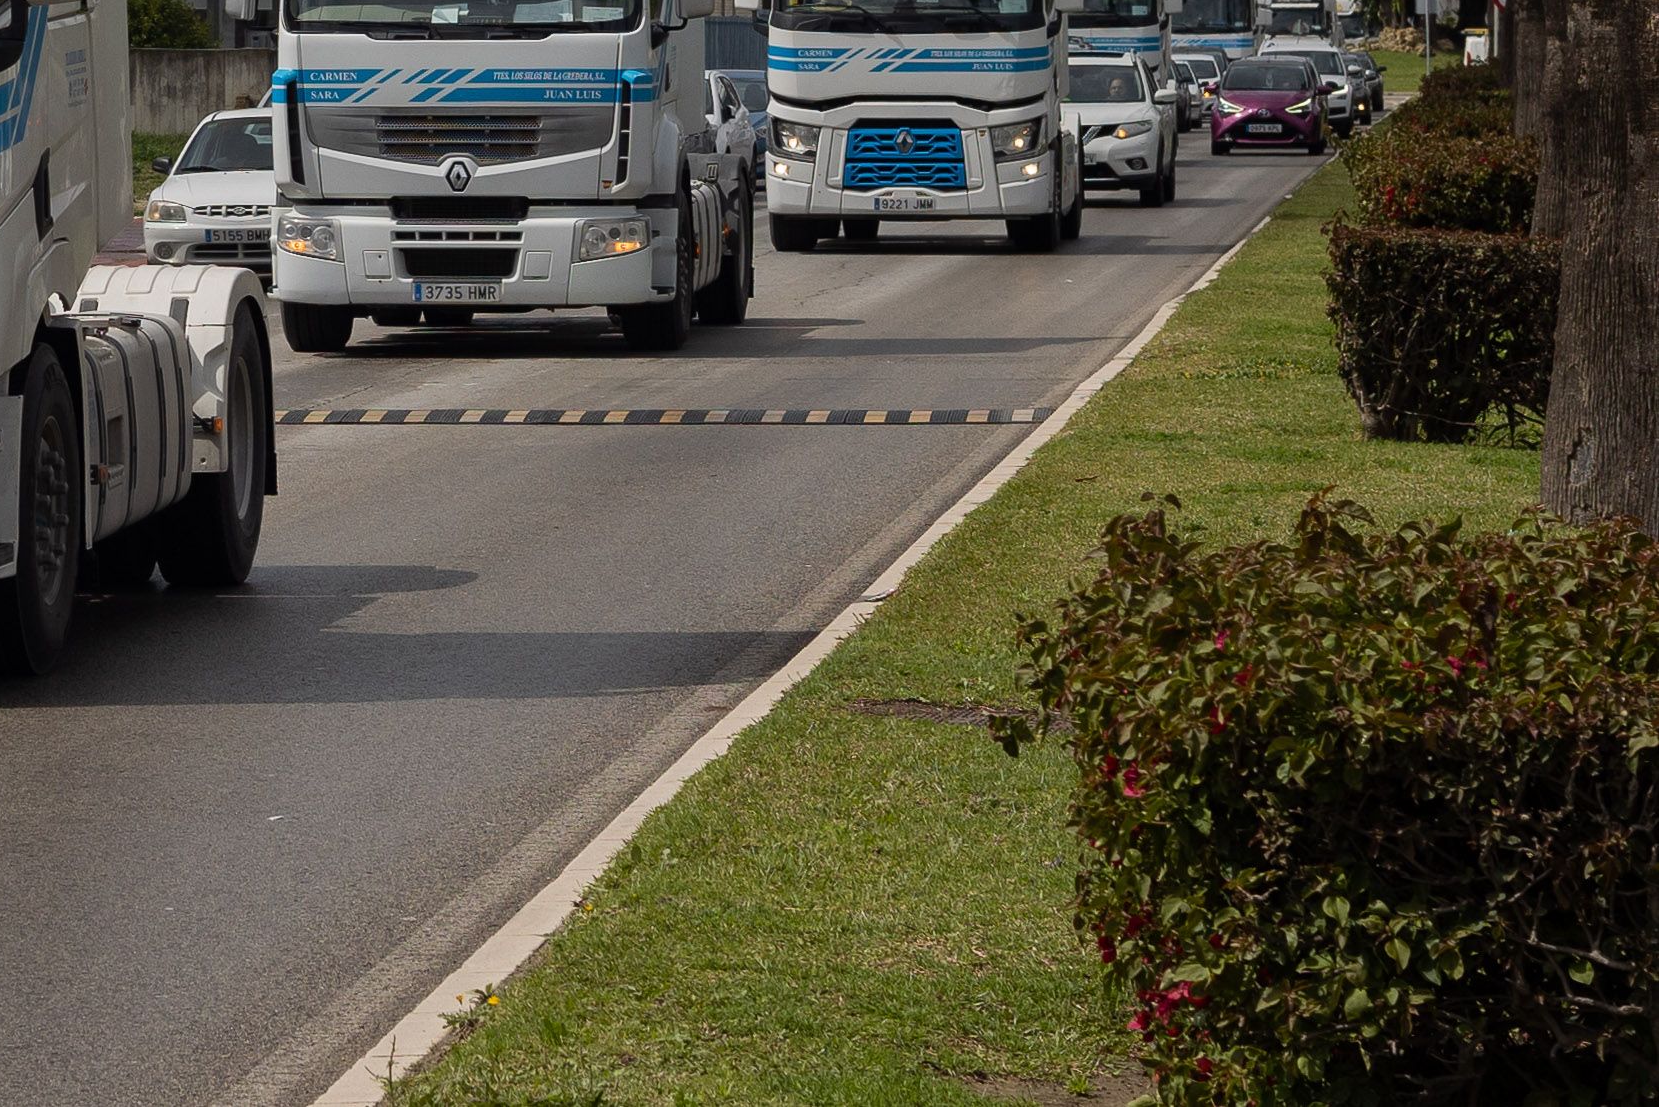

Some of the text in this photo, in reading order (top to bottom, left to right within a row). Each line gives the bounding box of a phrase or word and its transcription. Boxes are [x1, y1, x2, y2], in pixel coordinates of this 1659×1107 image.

[797, 49, 834, 57] CARMEN
[310, 72, 358, 81] CARMEN
[310, 90, 340, 100] SARA
[544, 89, 602, 99] JUAN LUIS
[881, 199, 908, 209] 9221
[212, 230, 271, 241] 5155 BMH
[425, 286, 496, 300] 3735 HMR
